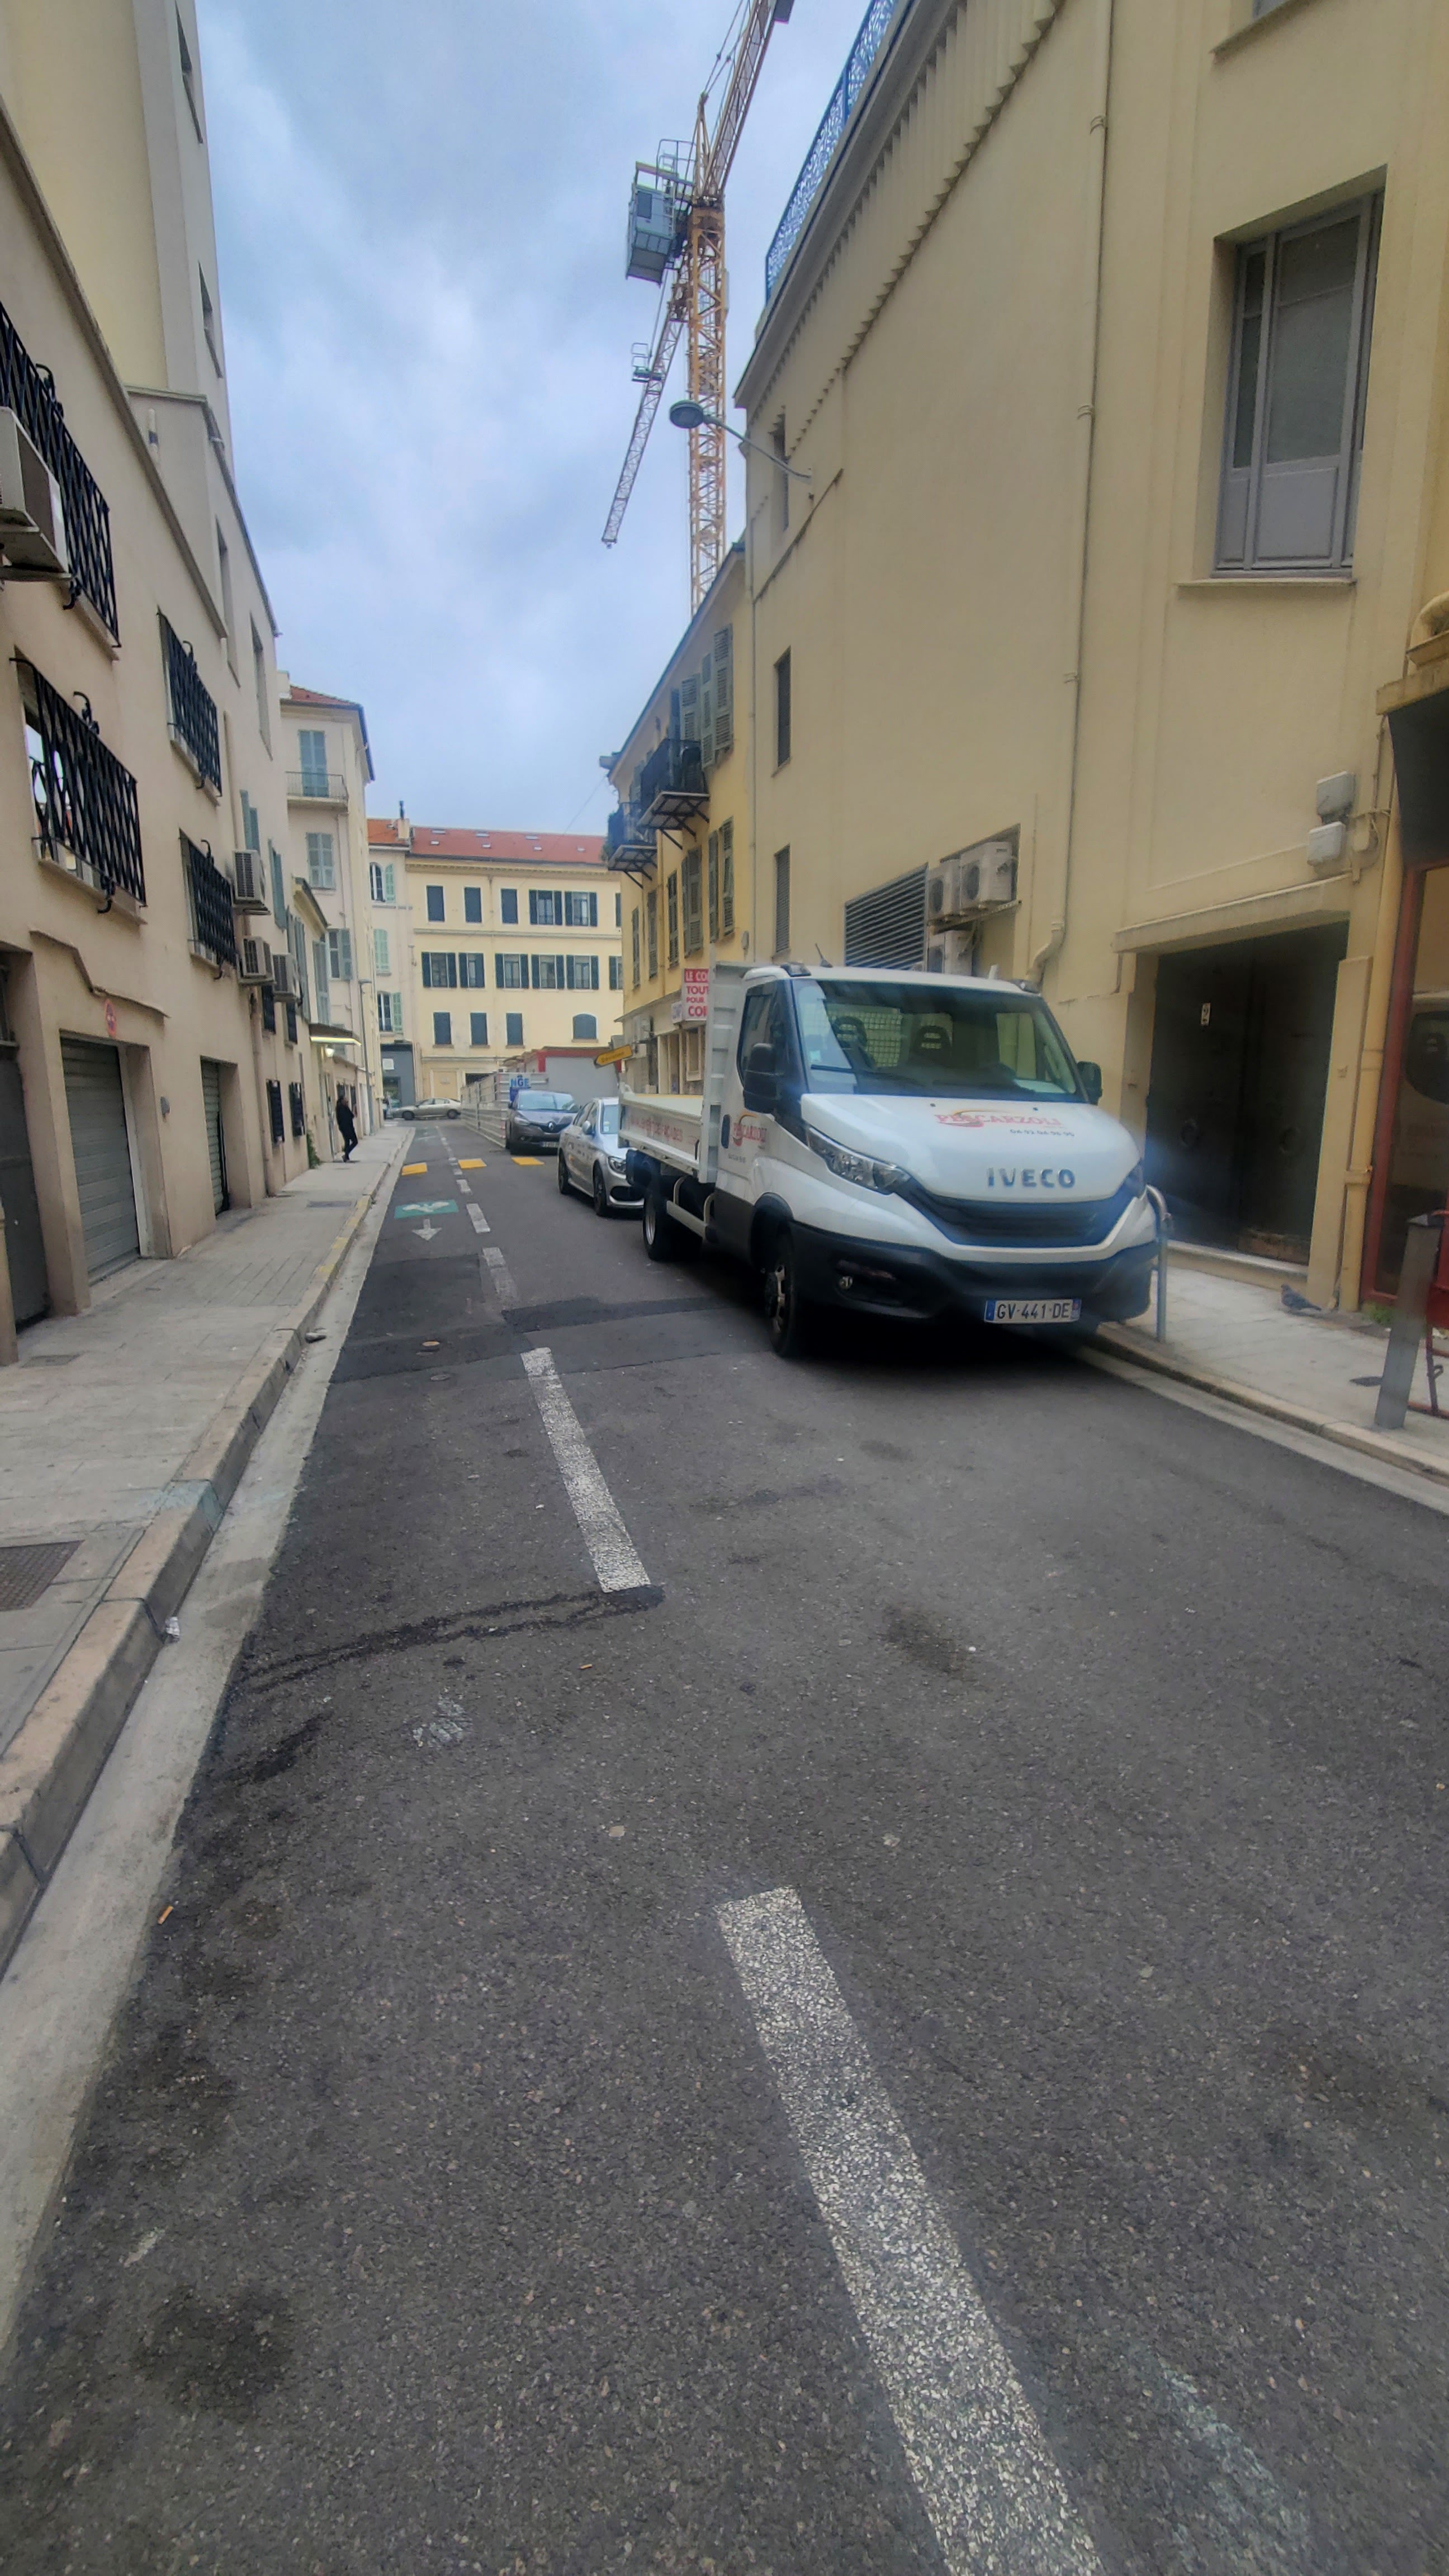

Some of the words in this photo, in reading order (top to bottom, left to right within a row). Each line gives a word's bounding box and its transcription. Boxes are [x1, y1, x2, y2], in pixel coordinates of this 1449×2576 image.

[686, 972, 693, 981] LE
[987, 1167, 1076, 1188] IVECO
[997, 1303, 1071, 1320] GV-441-DE
